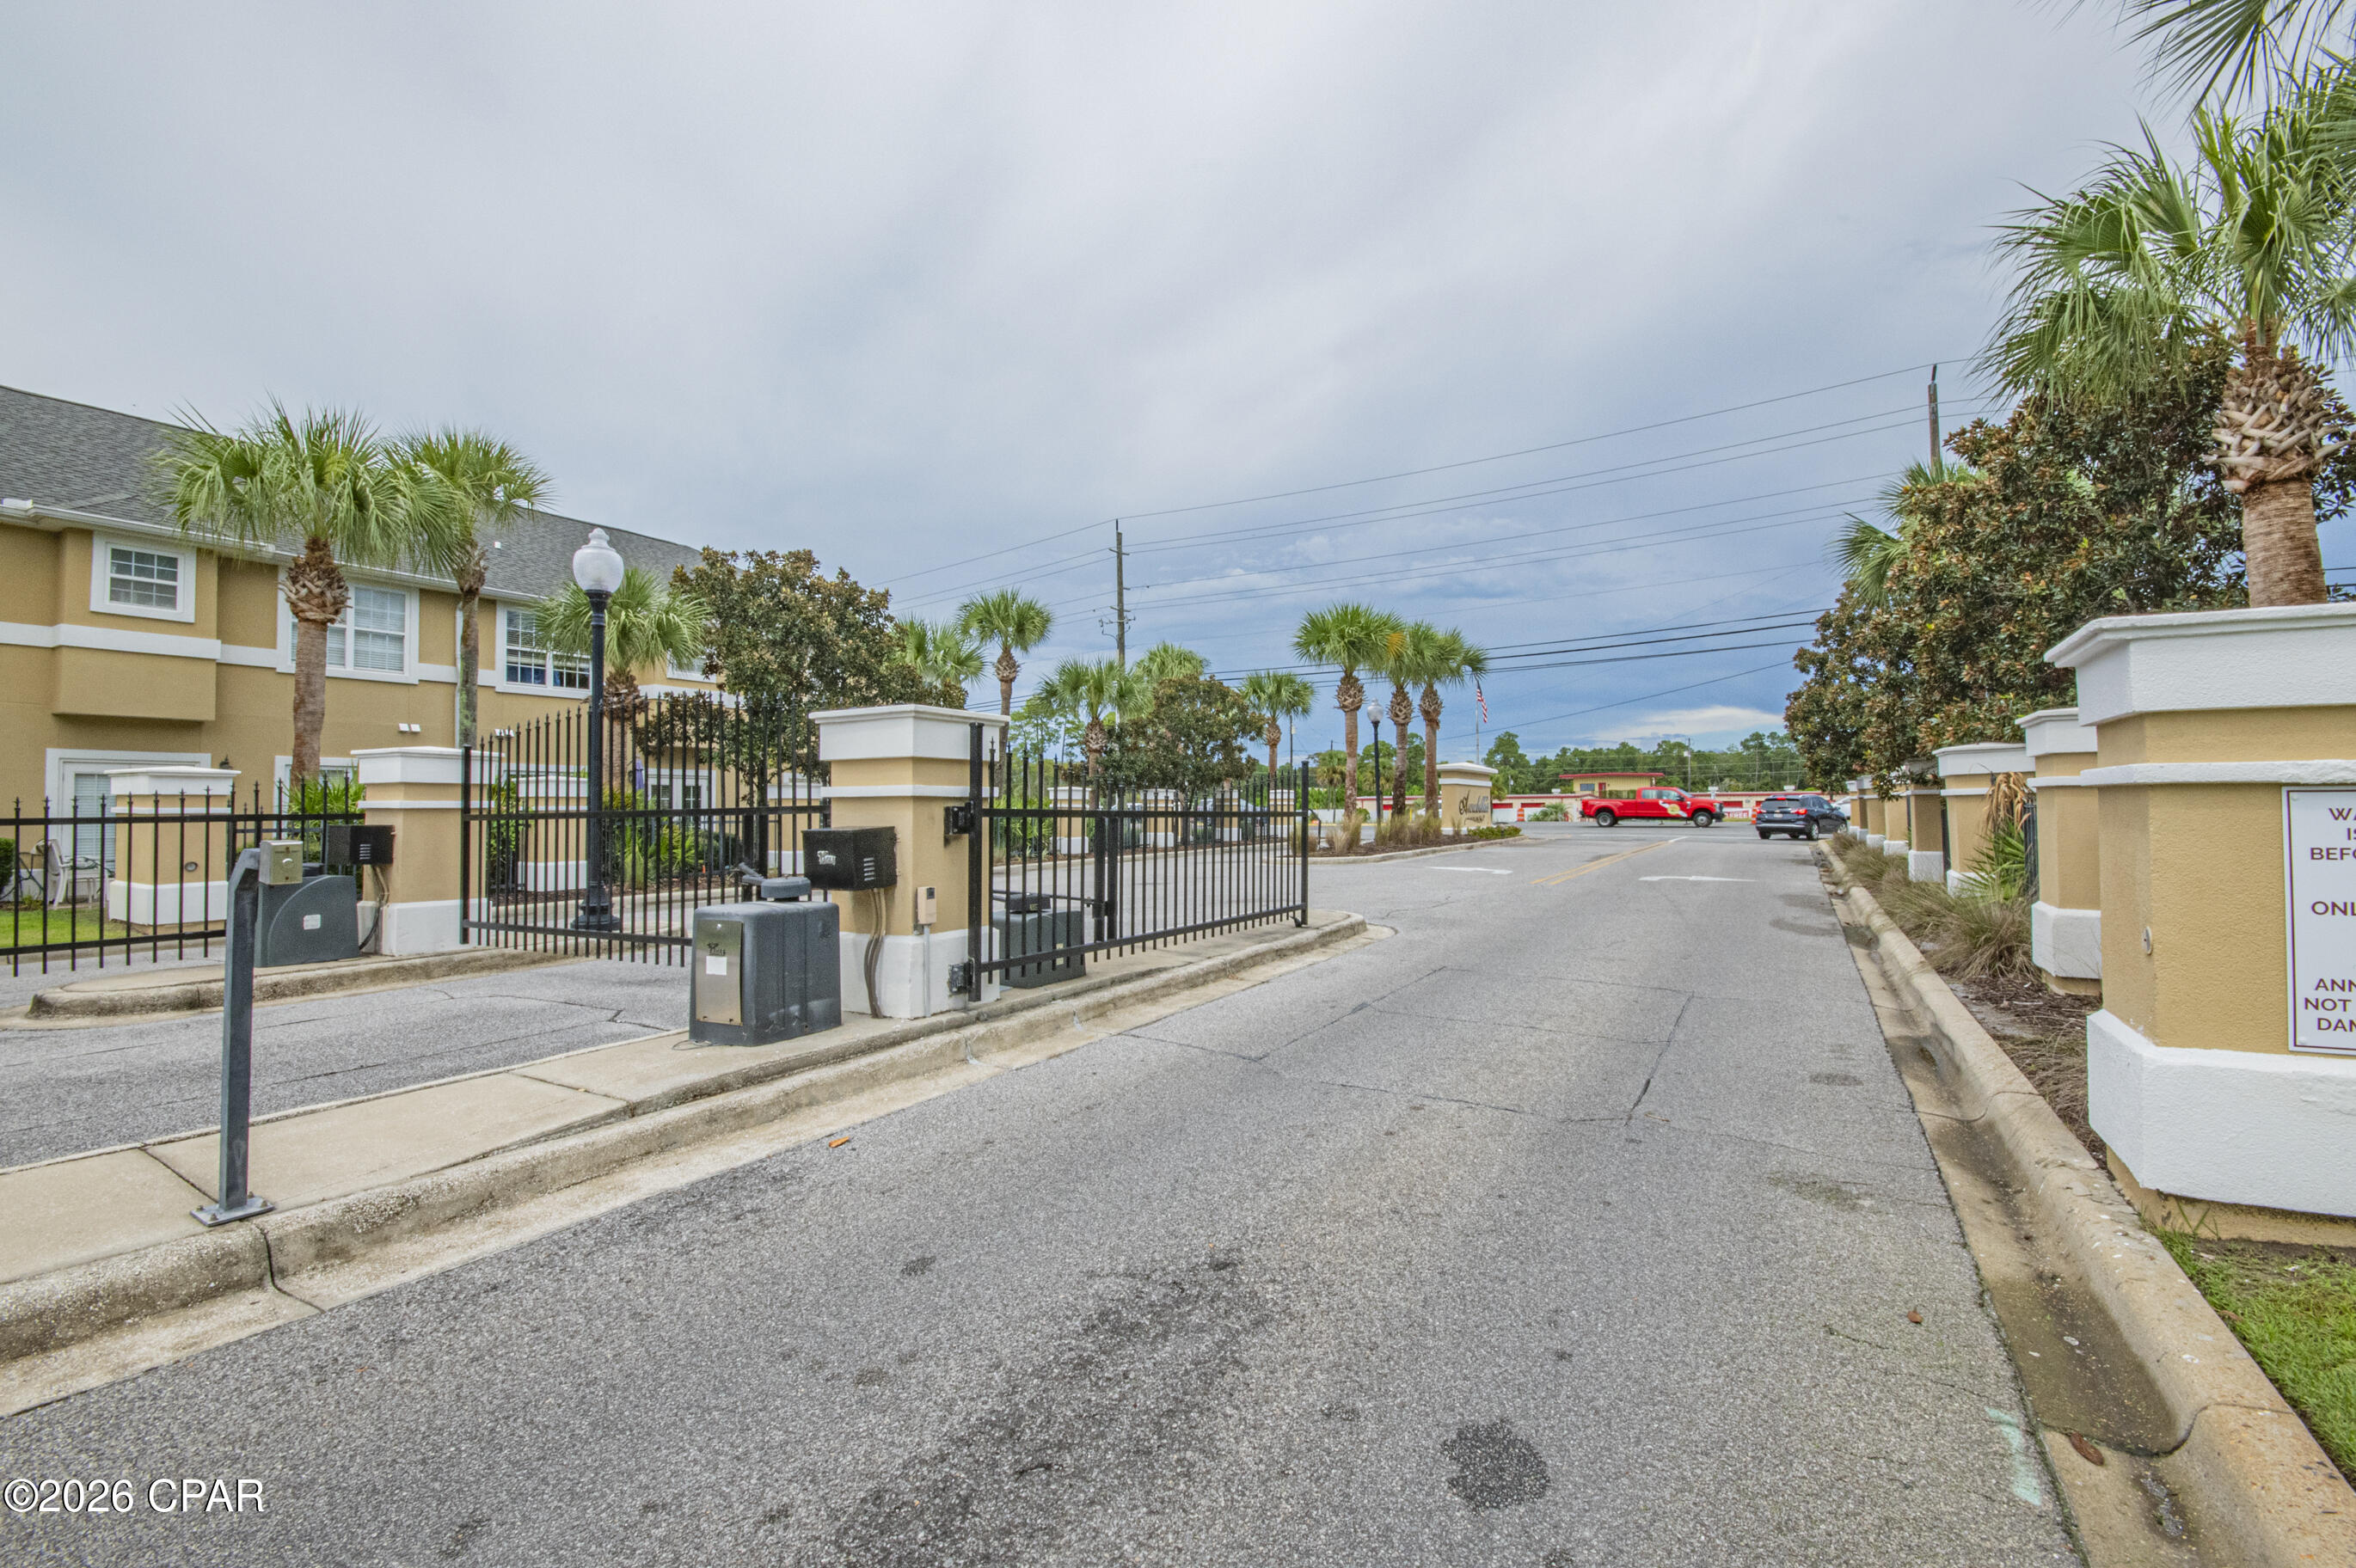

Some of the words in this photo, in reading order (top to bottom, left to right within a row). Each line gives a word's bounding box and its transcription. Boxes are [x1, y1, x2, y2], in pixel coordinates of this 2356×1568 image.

[2328, 807, 2356, 821] W
[2310, 847, 2356, 861] BEF
[2304, 997, 2353, 1013] NOT
